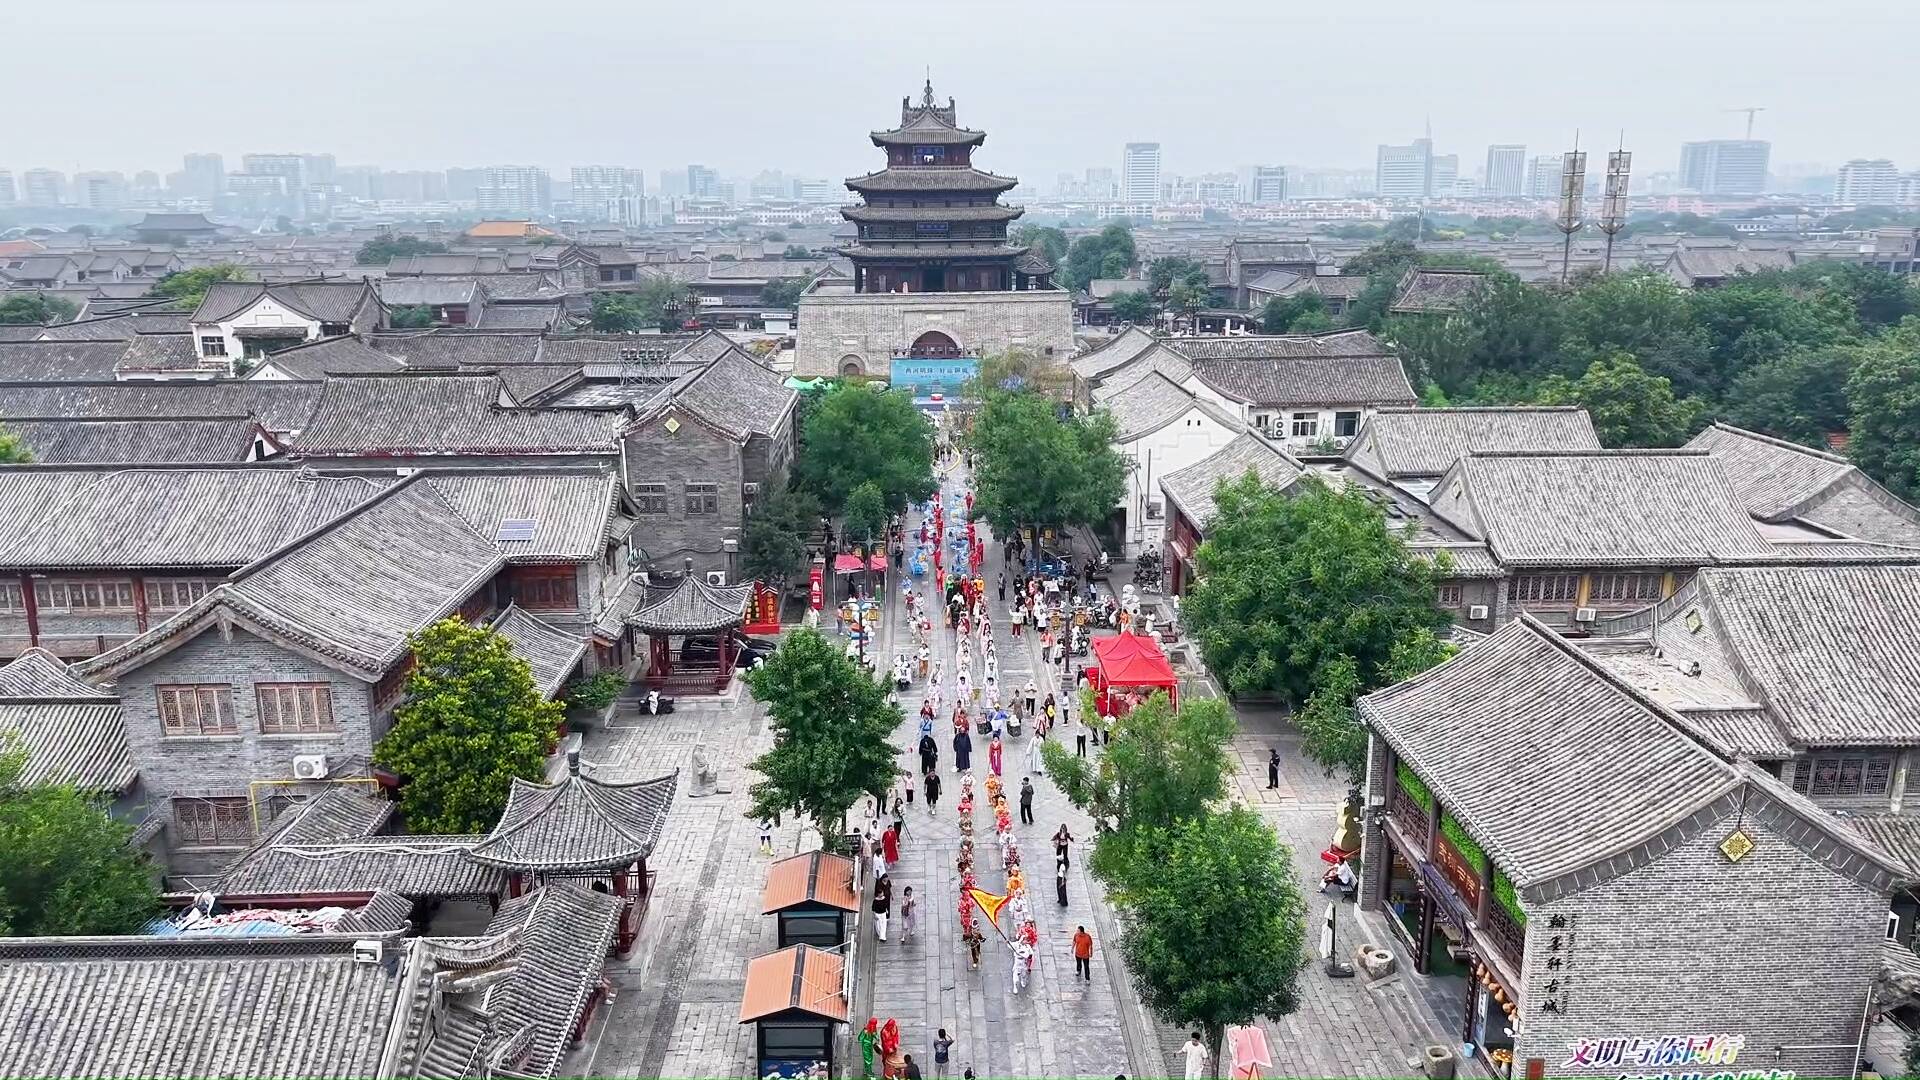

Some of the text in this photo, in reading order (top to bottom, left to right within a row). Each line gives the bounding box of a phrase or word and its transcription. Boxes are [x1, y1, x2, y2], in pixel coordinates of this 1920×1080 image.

[1562, 1034, 1745, 1067] 文明与你同行
